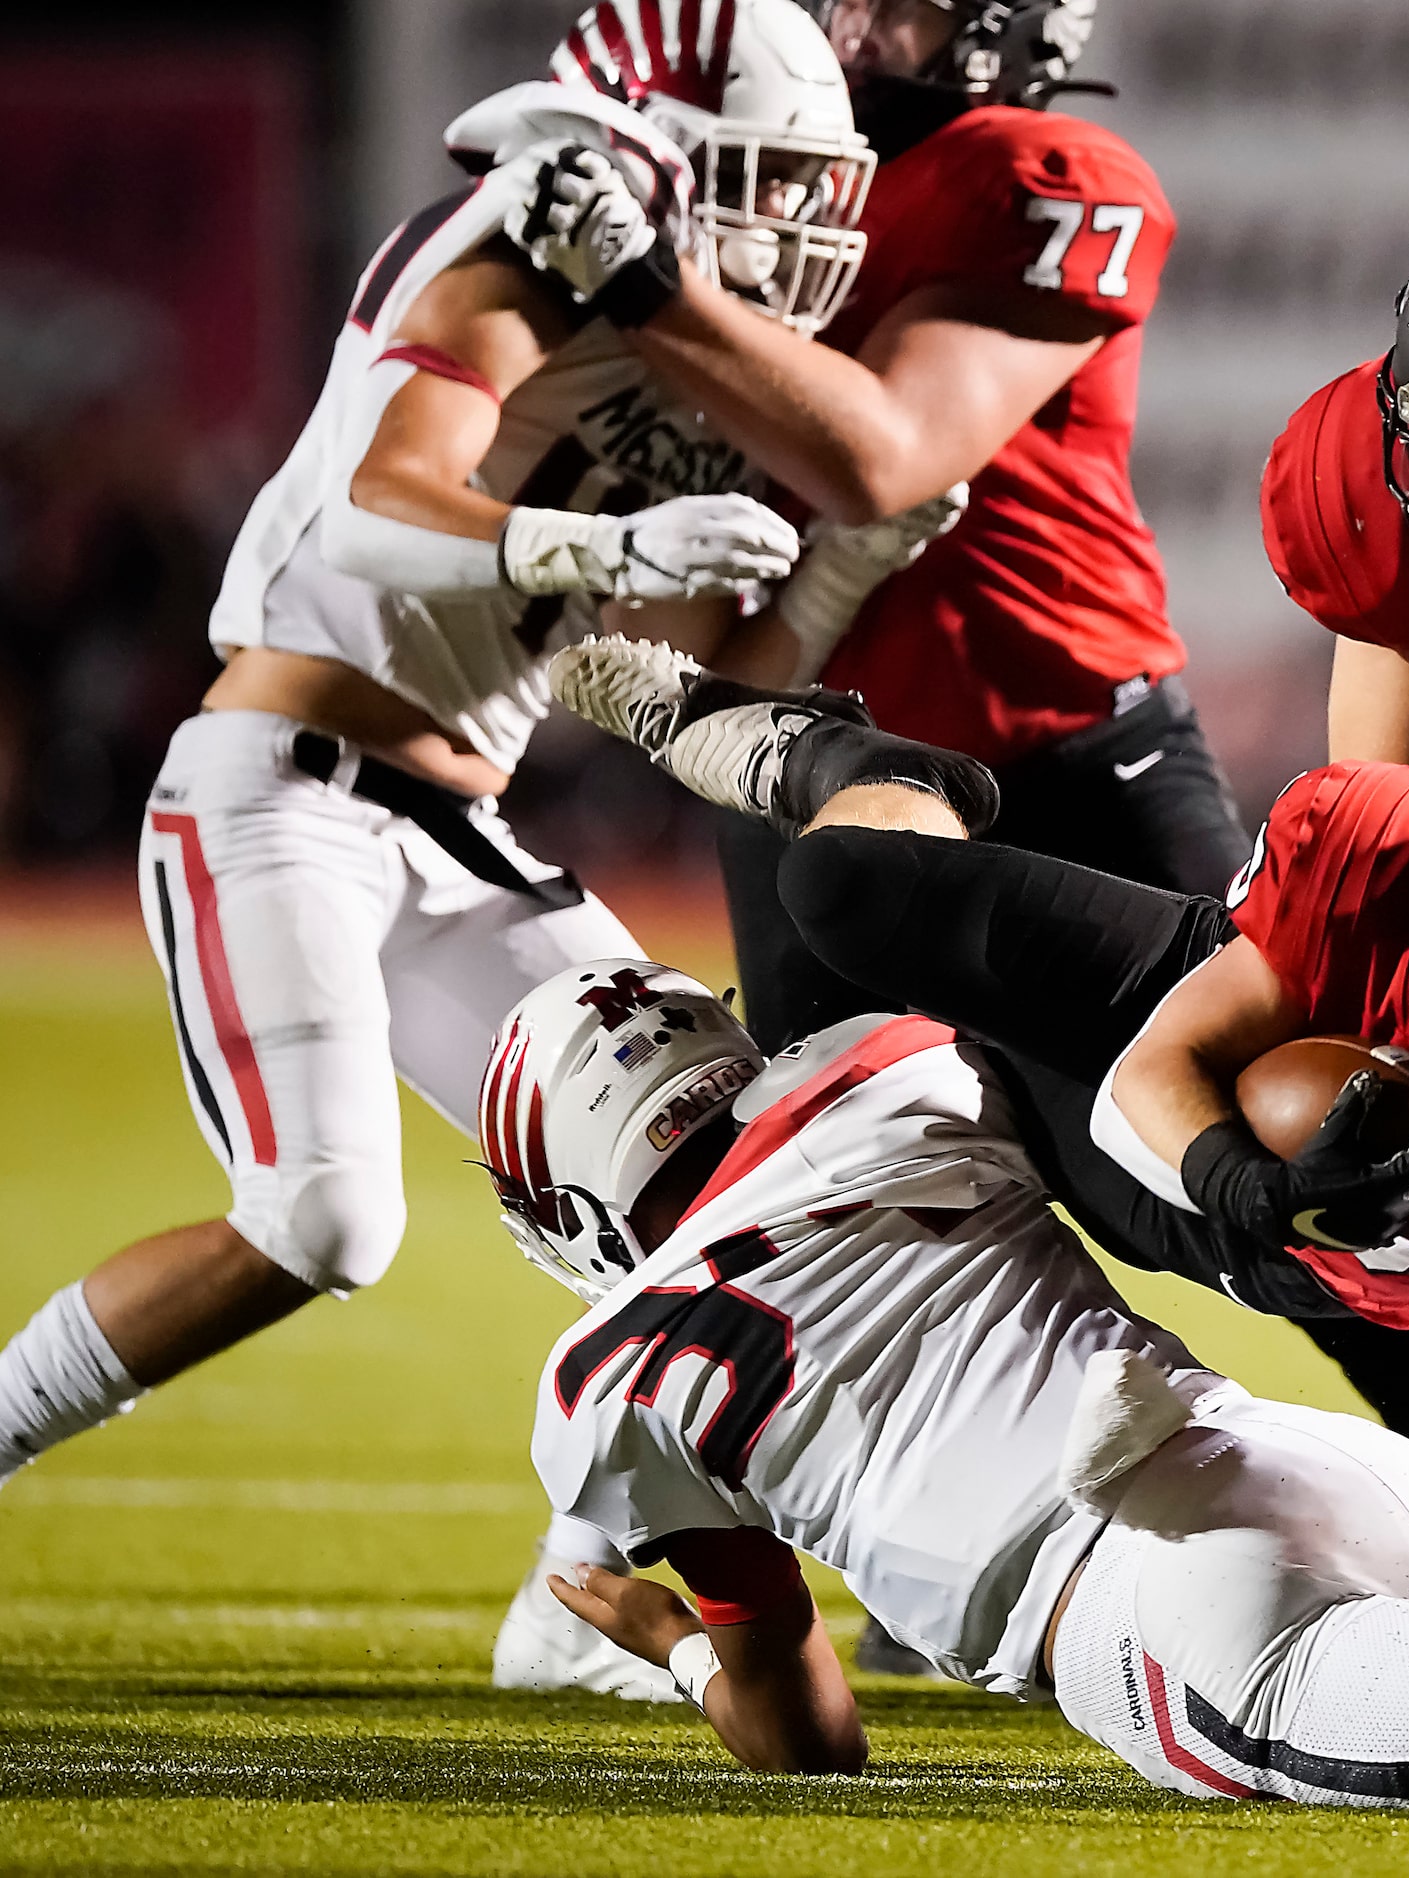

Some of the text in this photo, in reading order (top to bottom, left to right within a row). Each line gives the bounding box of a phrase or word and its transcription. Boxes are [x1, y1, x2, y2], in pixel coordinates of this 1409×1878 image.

[1023, 196, 1144, 298] 77
[575, 967, 666, 1033] M
[645, 1058, 760, 1152] CARDS
[1119, 1636, 1146, 1731] CARDINALS
